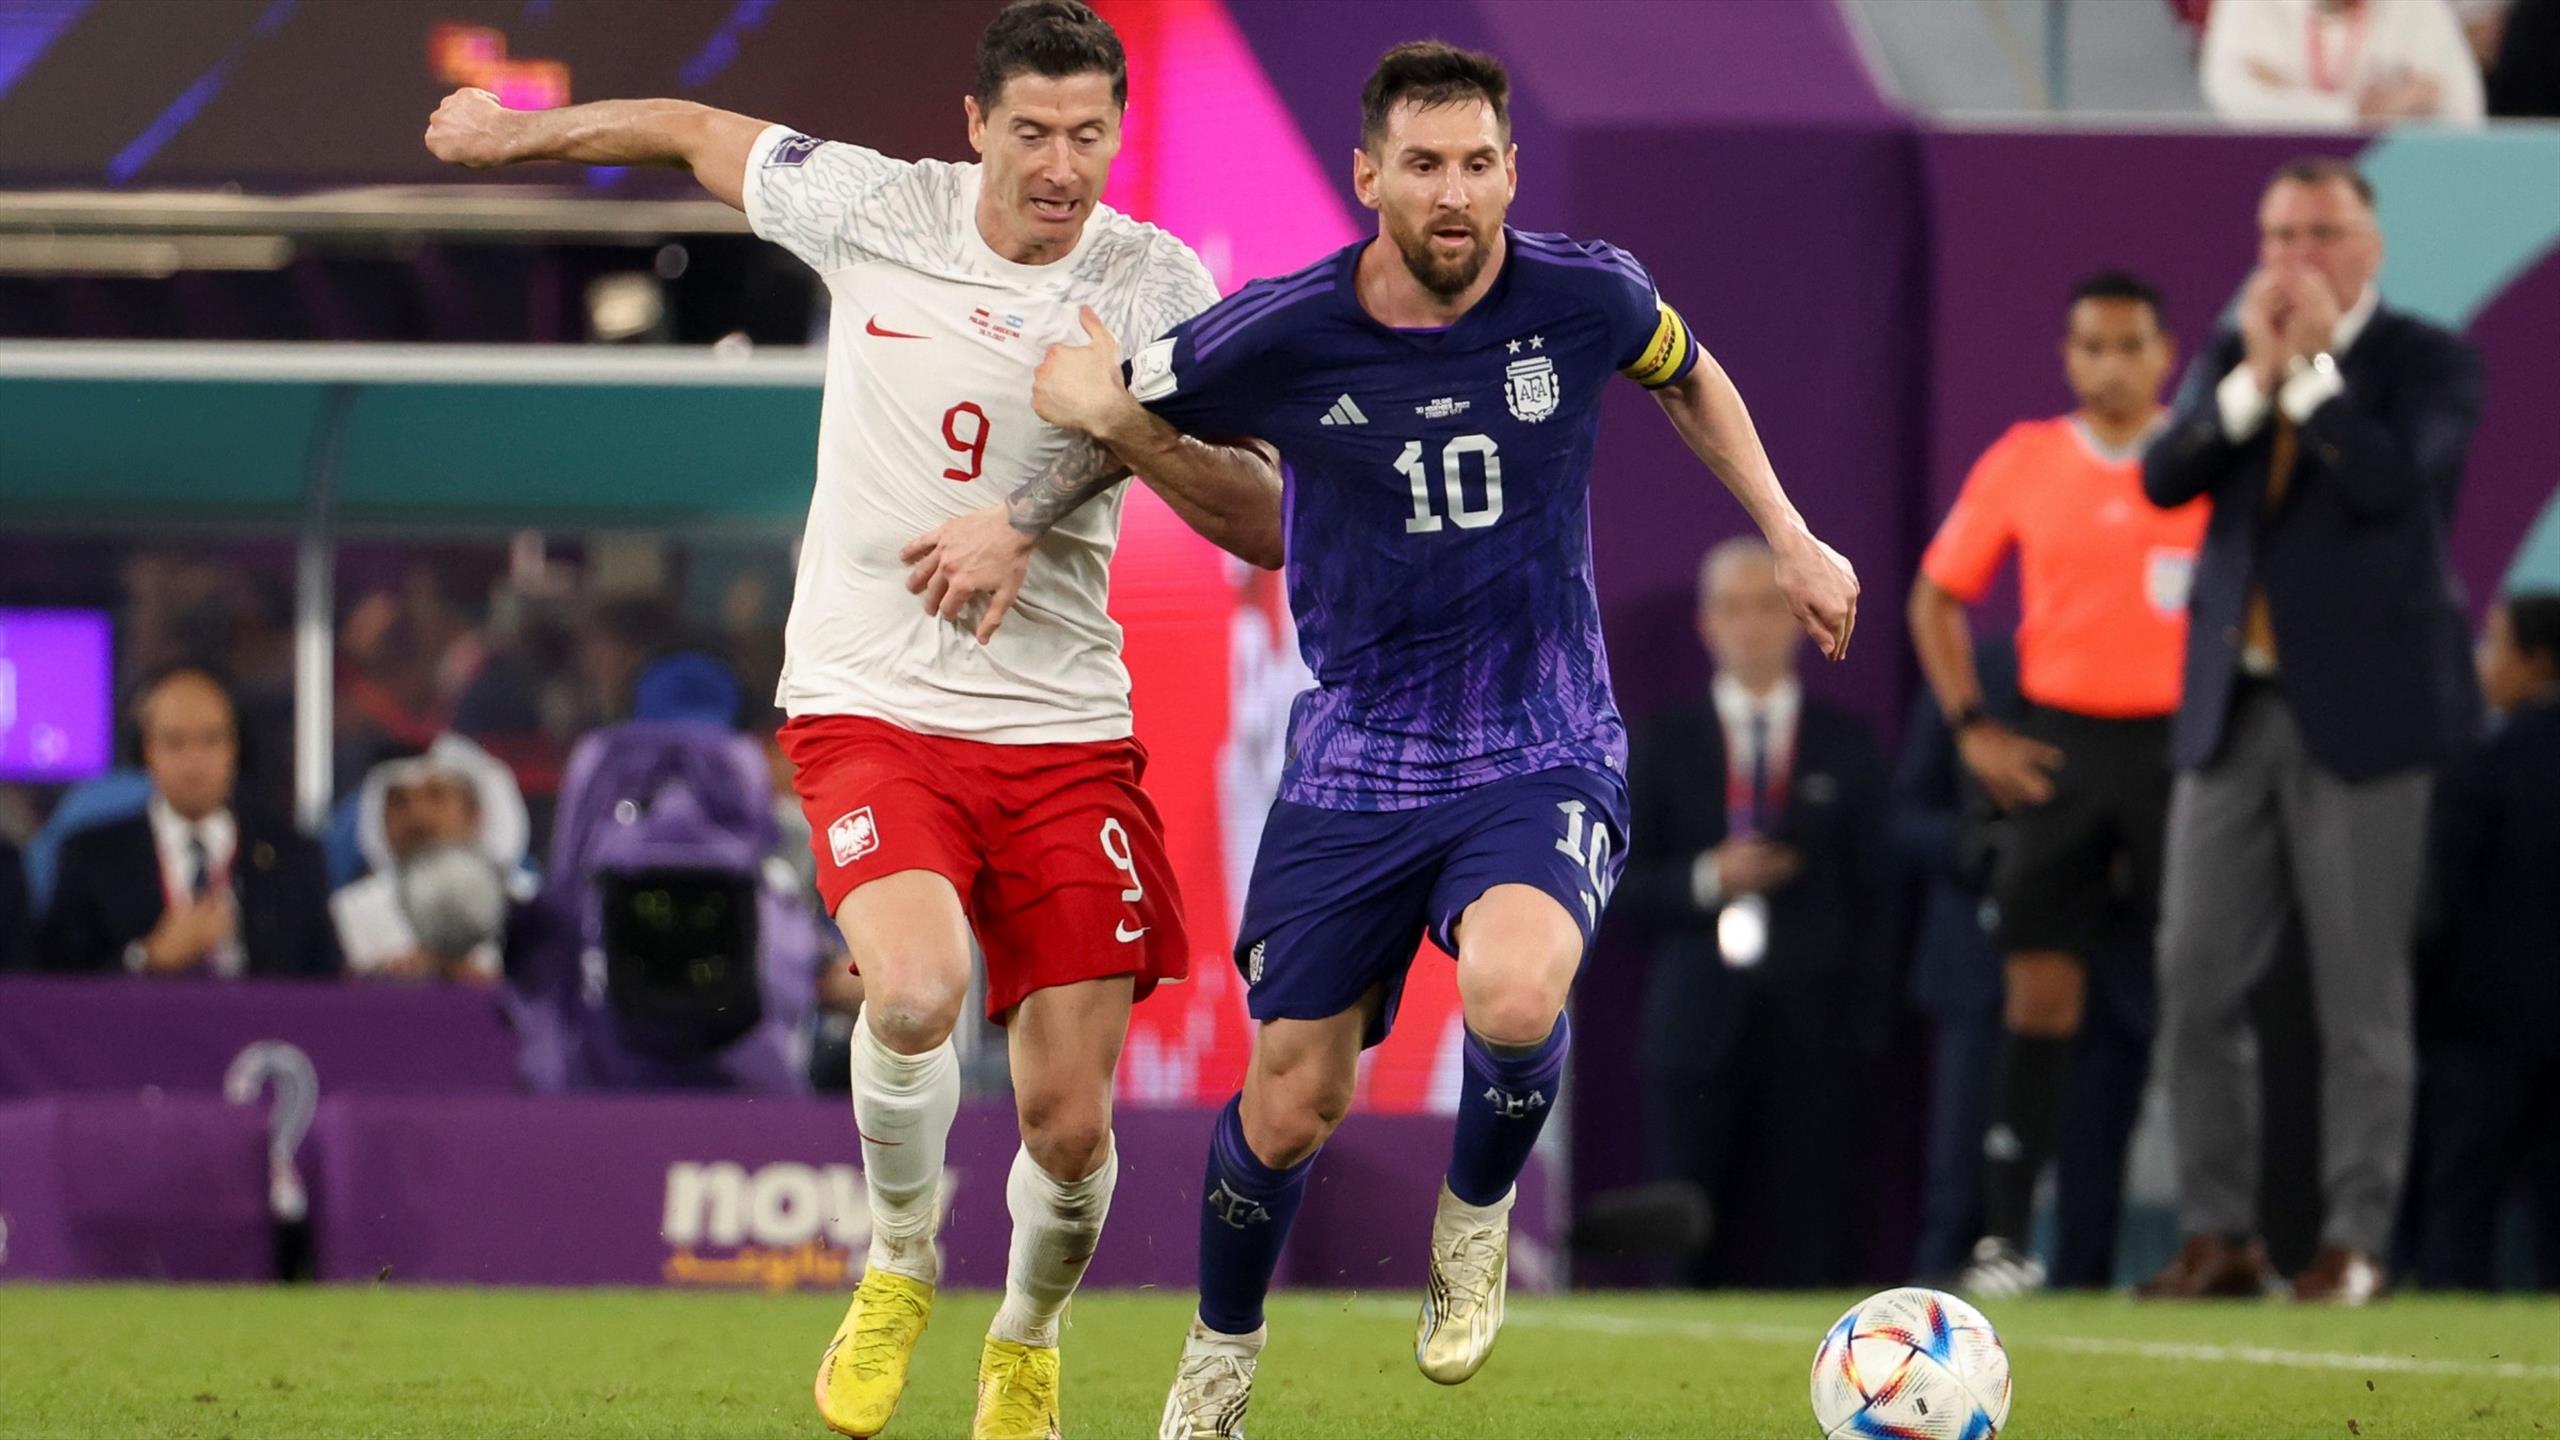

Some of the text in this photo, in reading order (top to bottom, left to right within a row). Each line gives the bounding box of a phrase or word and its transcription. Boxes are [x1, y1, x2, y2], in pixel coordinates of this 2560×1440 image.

[1520, 375, 1548, 403] AFA
[941, 401, 990, 482] 9
[1393, 433, 1503, 533] 10
[1100, 817, 1143, 902] 9
[1555, 799, 1611, 909] 10
